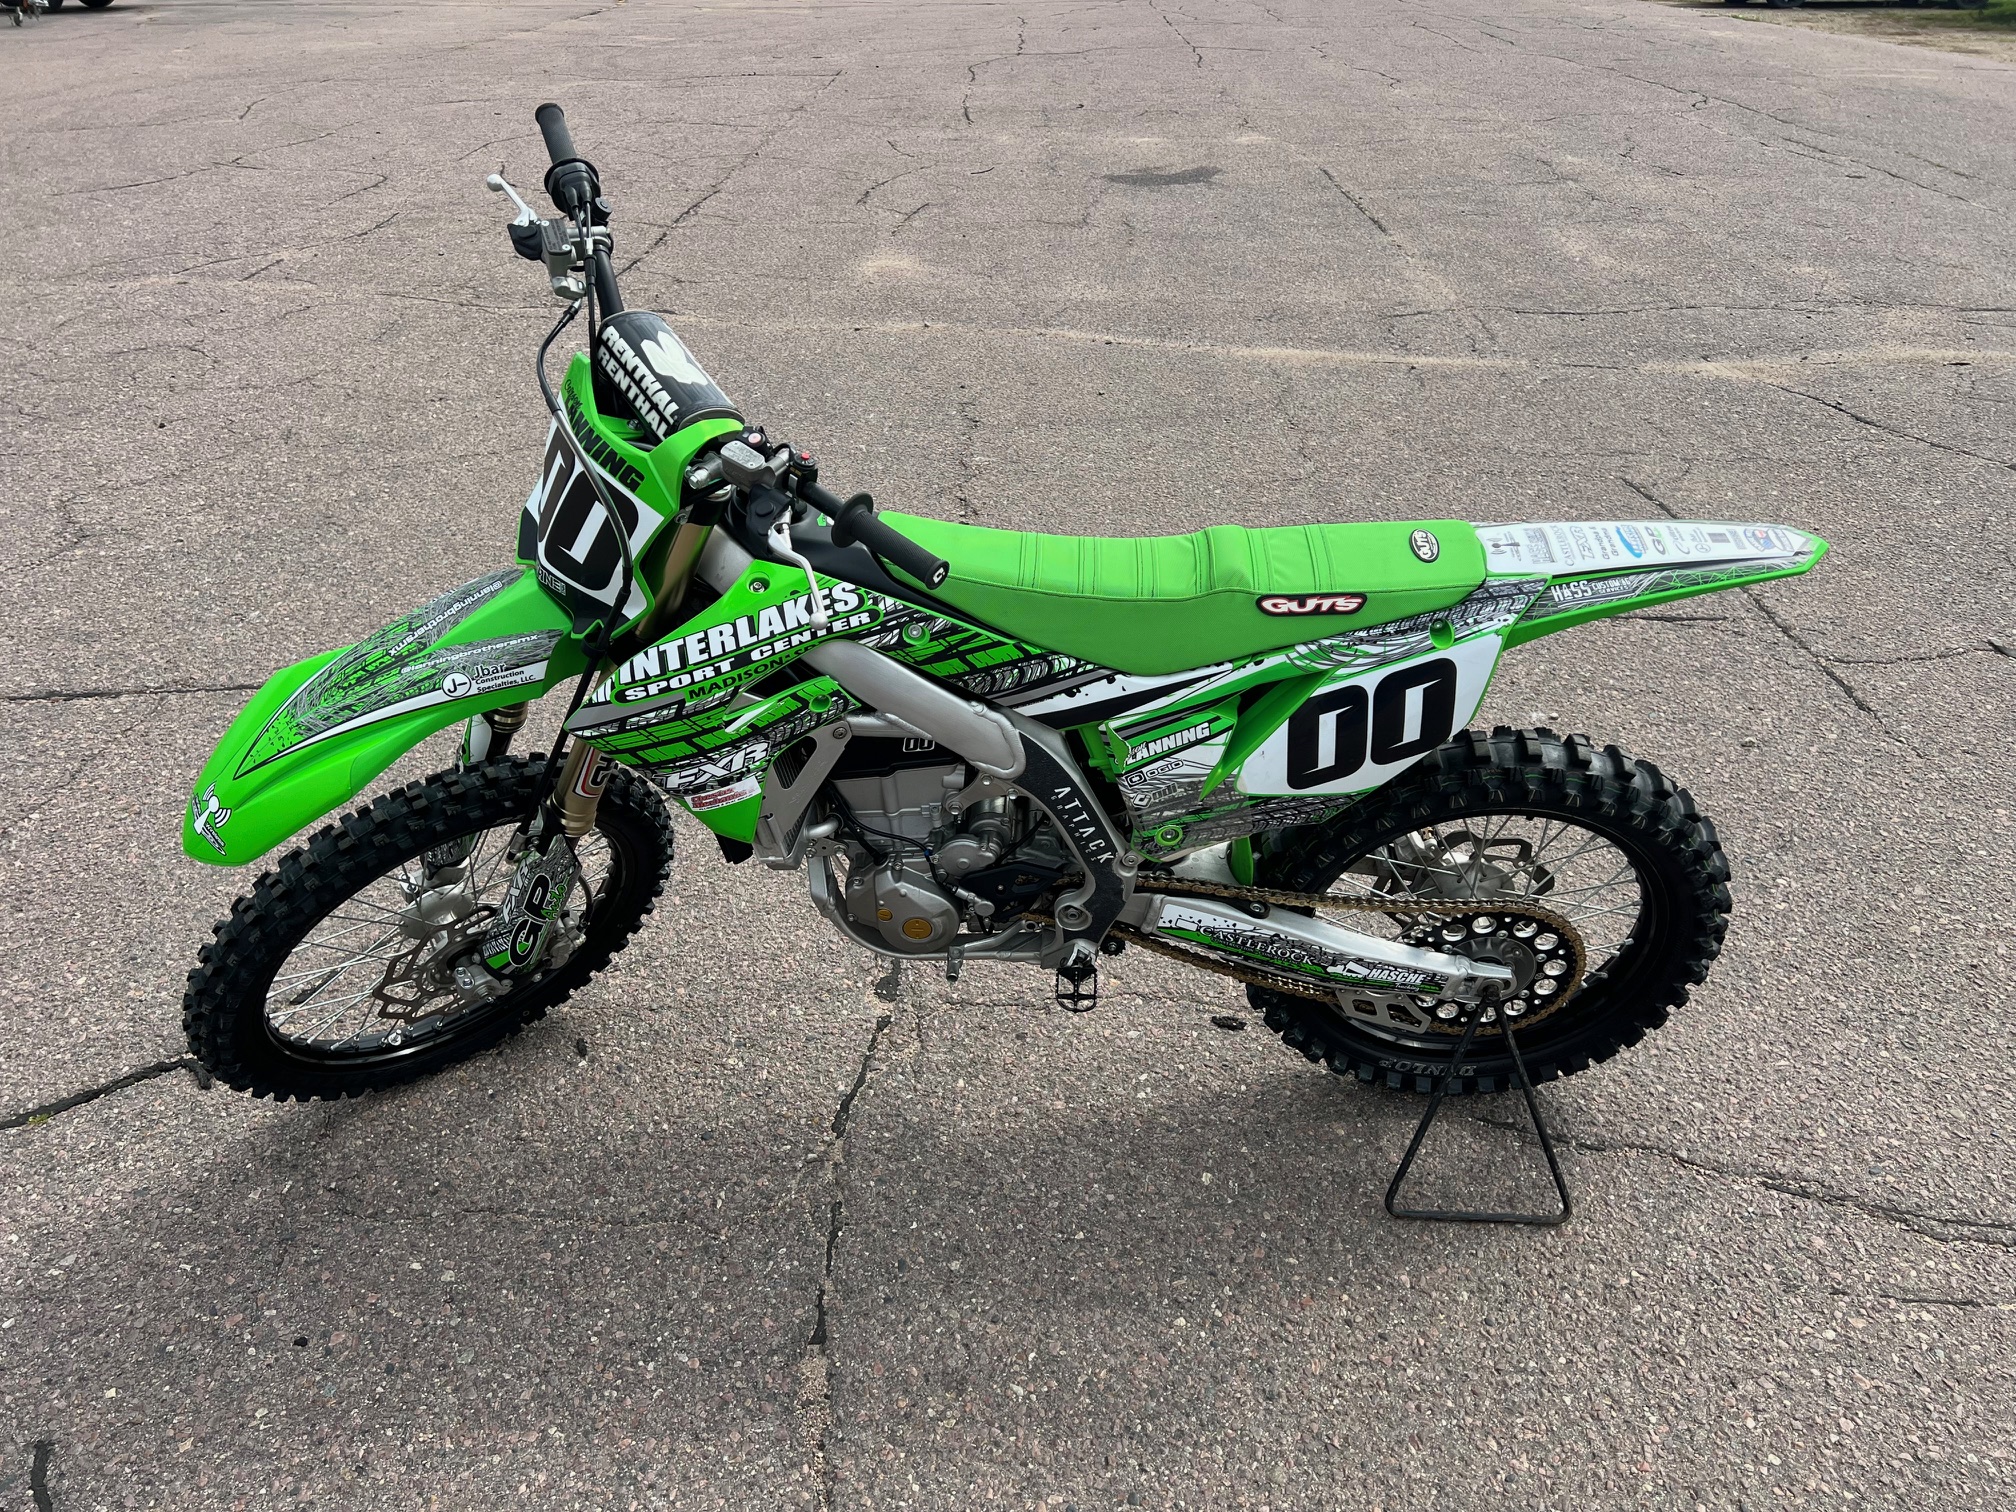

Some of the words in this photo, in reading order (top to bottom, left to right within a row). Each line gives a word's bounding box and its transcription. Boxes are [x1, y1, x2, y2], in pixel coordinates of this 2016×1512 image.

[598, 345, 670, 442] RENTHAL
[601, 325, 679, 424] RENTHAL
[1261, 595, 1363, 614] GUTS
[1551, 580, 1593, 602] HASS
[618, 582, 858, 685] INTERLAKES
[474, 662, 506, 679] Jbar
[475, 669, 525, 685] Construction
[477, 680, 520, 693] Specialties,
[520, 675, 537, 684] LLC.
[624, 658, 735, 701] SPORT
[688, 657, 784, 700] MADISON
[1287, 657, 1457, 790] 00
[665, 741, 770, 789] FXR
[1146, 760, 1183, 778] OGIO
[1050, 795, 1097, 862] GRAPHICS
[1054, 787, 1115, 863] ATTACK
[508, 872, 552, 967] GP
[1200, 926, 1315, 966] CASTLEROCK
[1368, 968, 1427, 984] HASCHE
